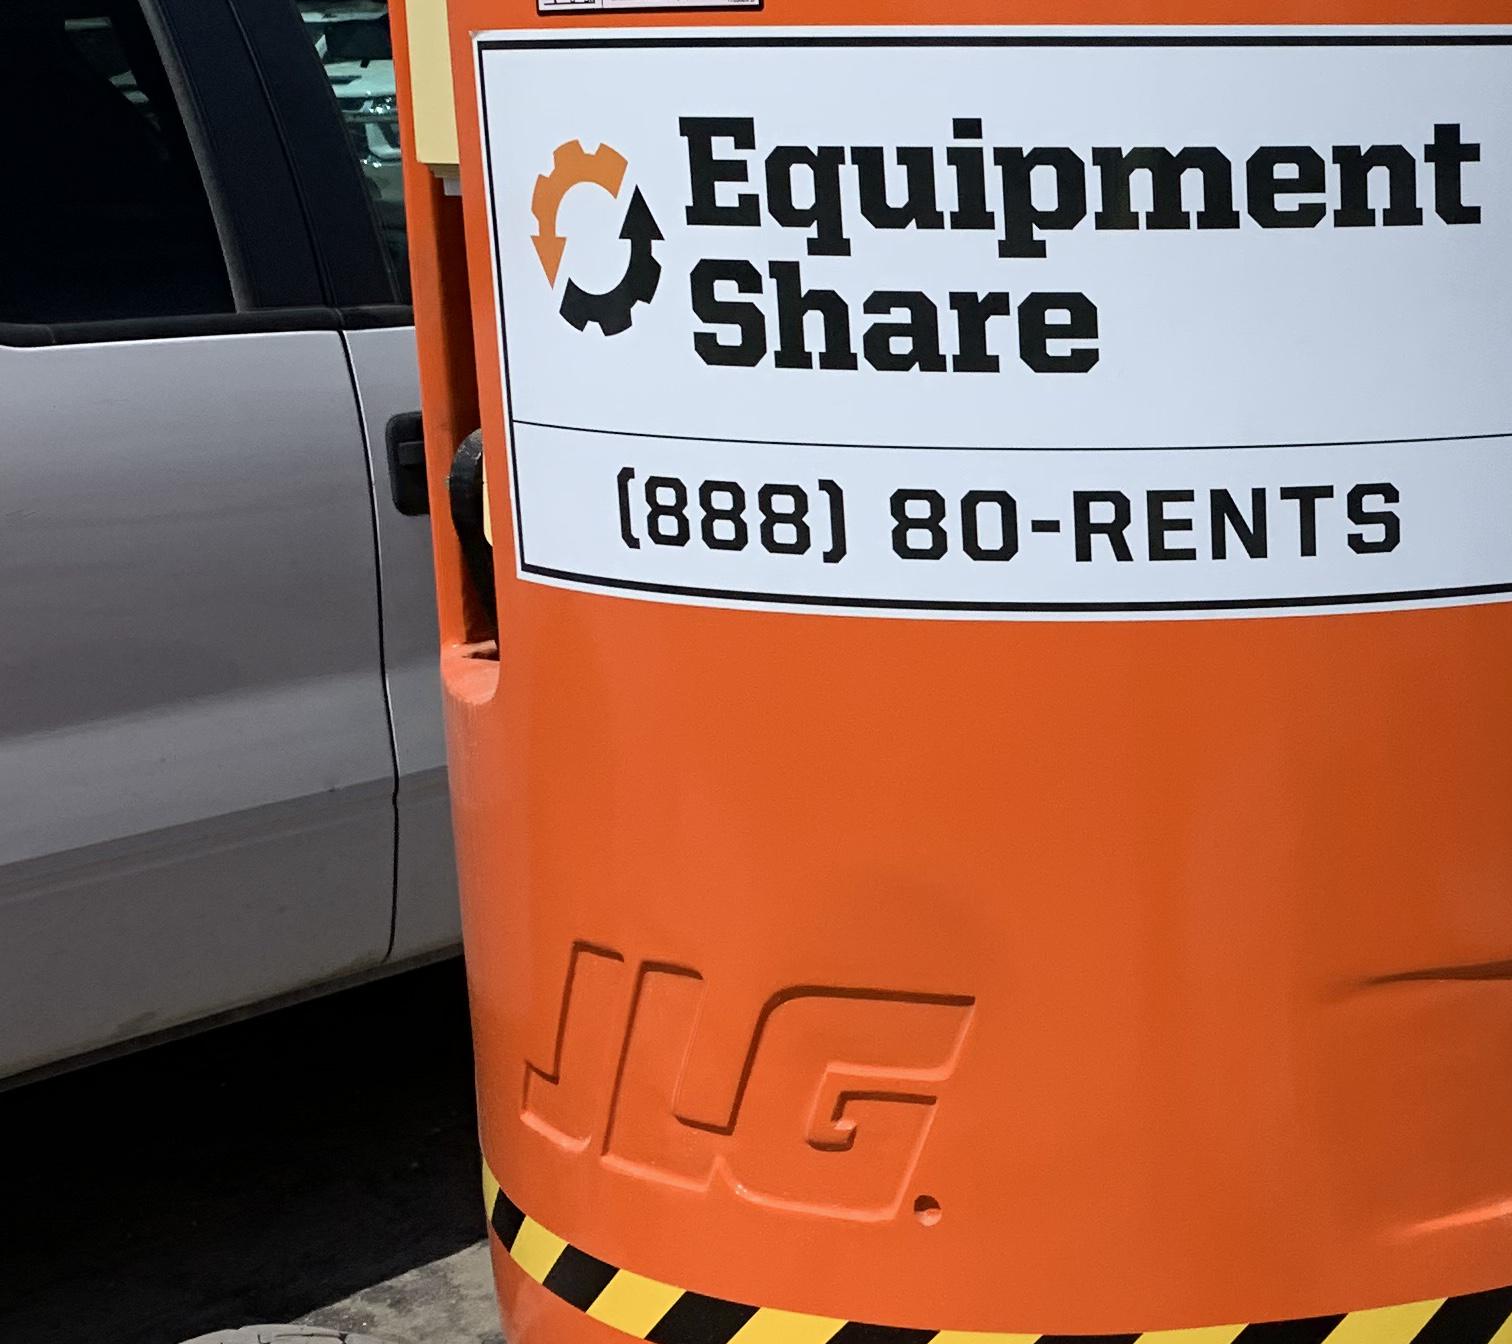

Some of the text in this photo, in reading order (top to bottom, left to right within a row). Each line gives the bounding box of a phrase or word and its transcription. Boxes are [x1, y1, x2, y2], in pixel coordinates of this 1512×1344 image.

[679, 115, 1481, 258] Equipment
[688, 258, 1099, 373] Share
[617, 466, 1401, 564] (888) 80-RENTS
[520, 941, 975, 1222] JLG
